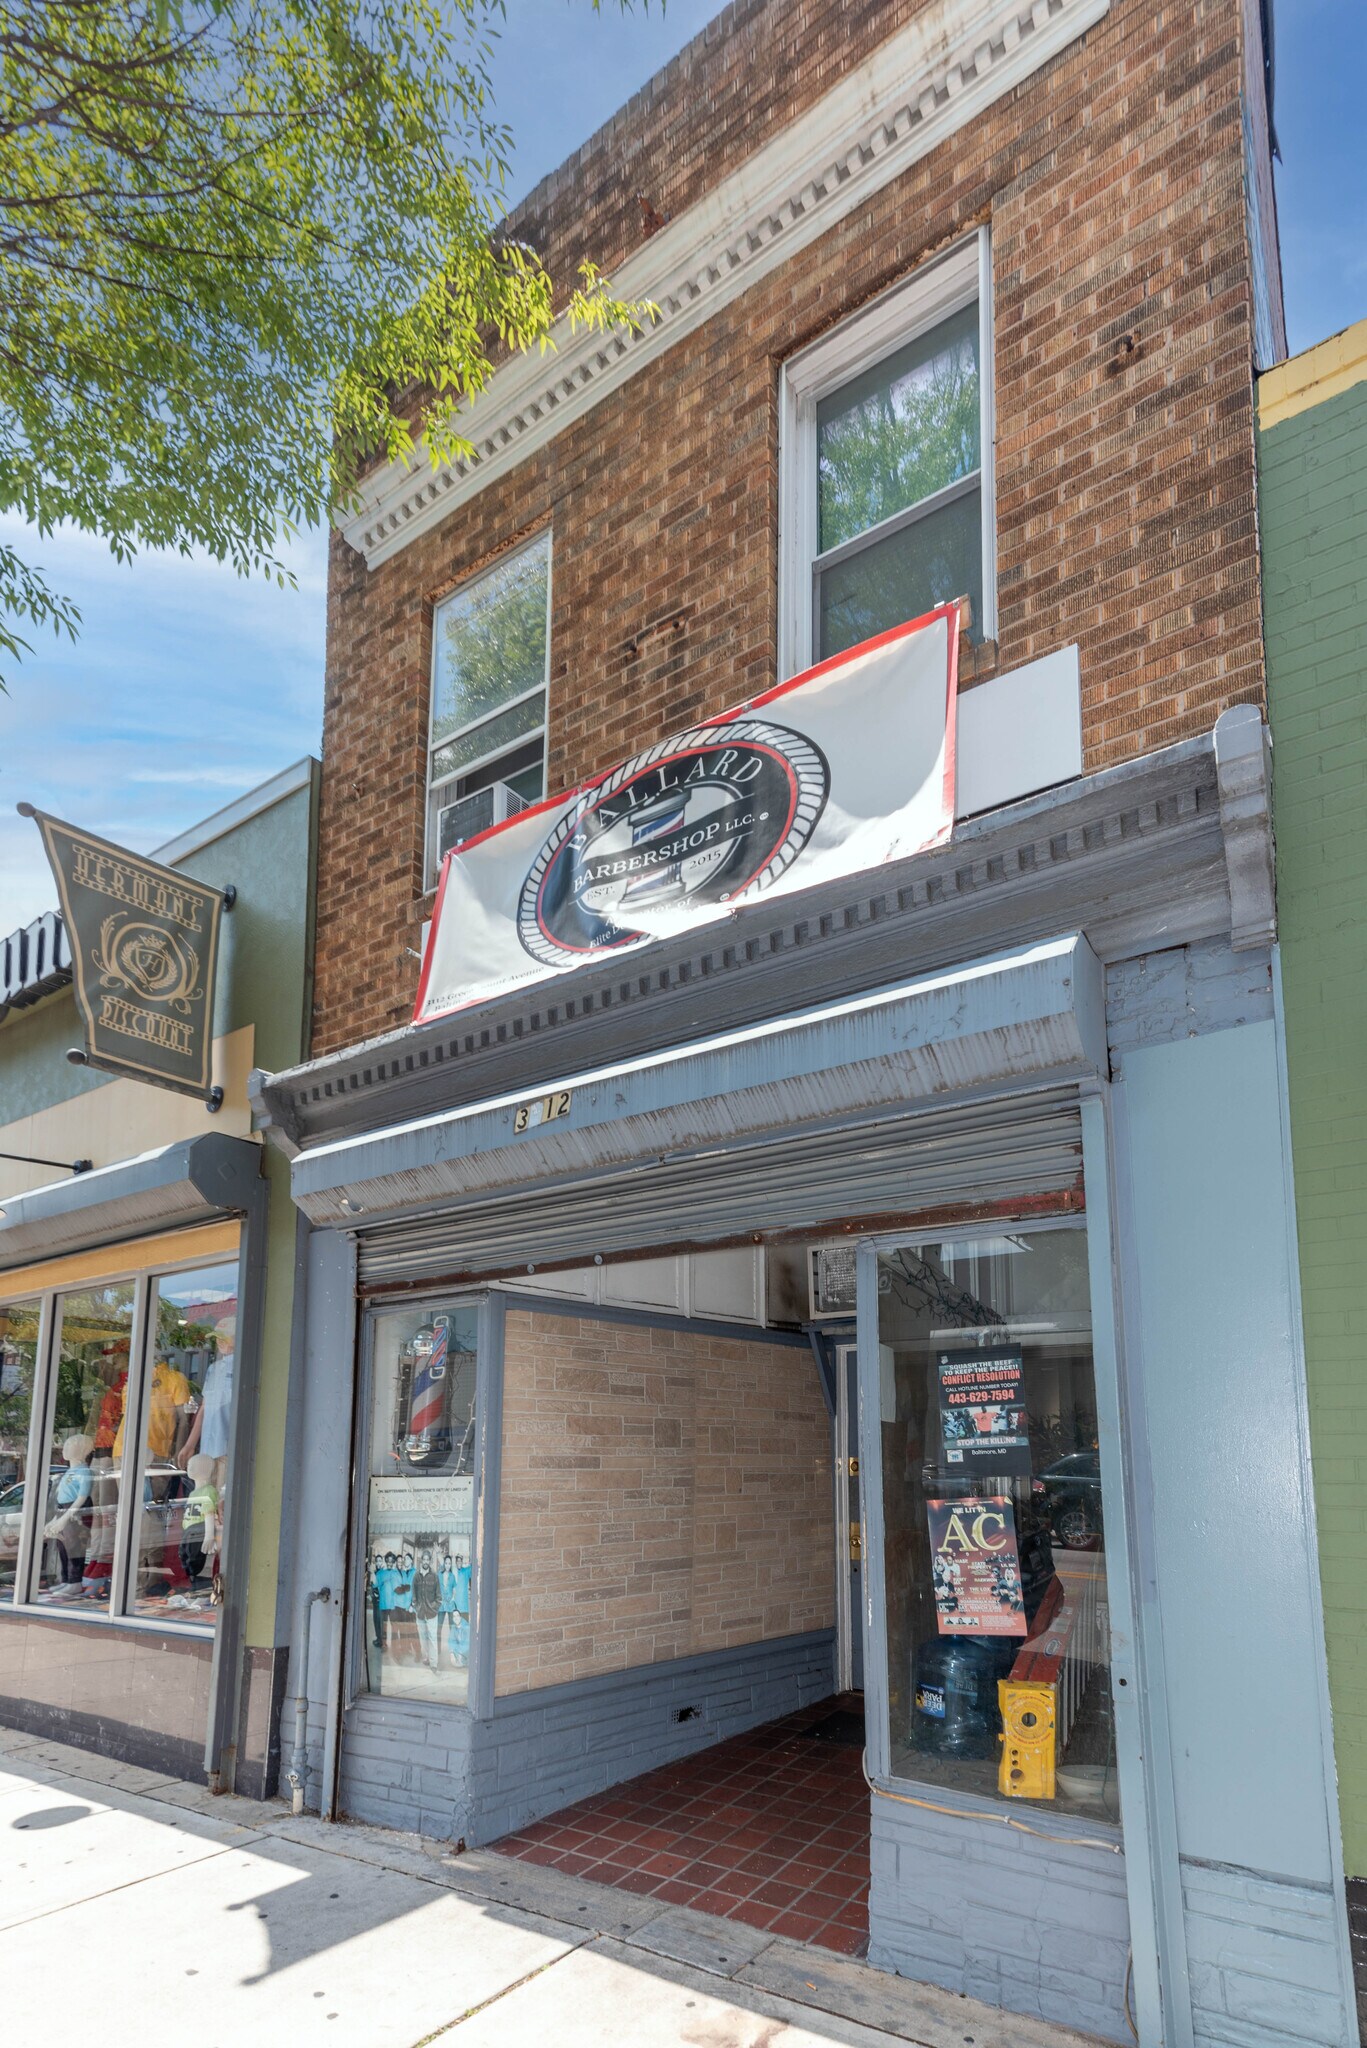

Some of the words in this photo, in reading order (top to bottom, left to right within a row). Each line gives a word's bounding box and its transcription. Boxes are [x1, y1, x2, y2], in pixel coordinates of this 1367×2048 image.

[566, 749, 763, 852] BALLARD
[574, 822, 720, 893] BARBERSHOP
[586, 885, 616, 901] EST.
[689, 850, 721, 870] 2015
[74, 854, 199, 925] HERMANS
[589, 930, 612, 949] Elite
[509, 967, 545, 982] Avenue
[102, 1000, 191, 1050] DISCOUNT
[942, 1373, 975, 1385] CONFLICT
[976, 1370, 1020, 1382] RESOLUTION
[948, 1389, 1015, 1404] 443-629-7594
[991, 1436, 1017, 1444] KILLING
[937, 1512, 1007, 1553] AC
[922, 1690, 943, 1703] PARK
[923, 1700, 943, 1711] DEER
